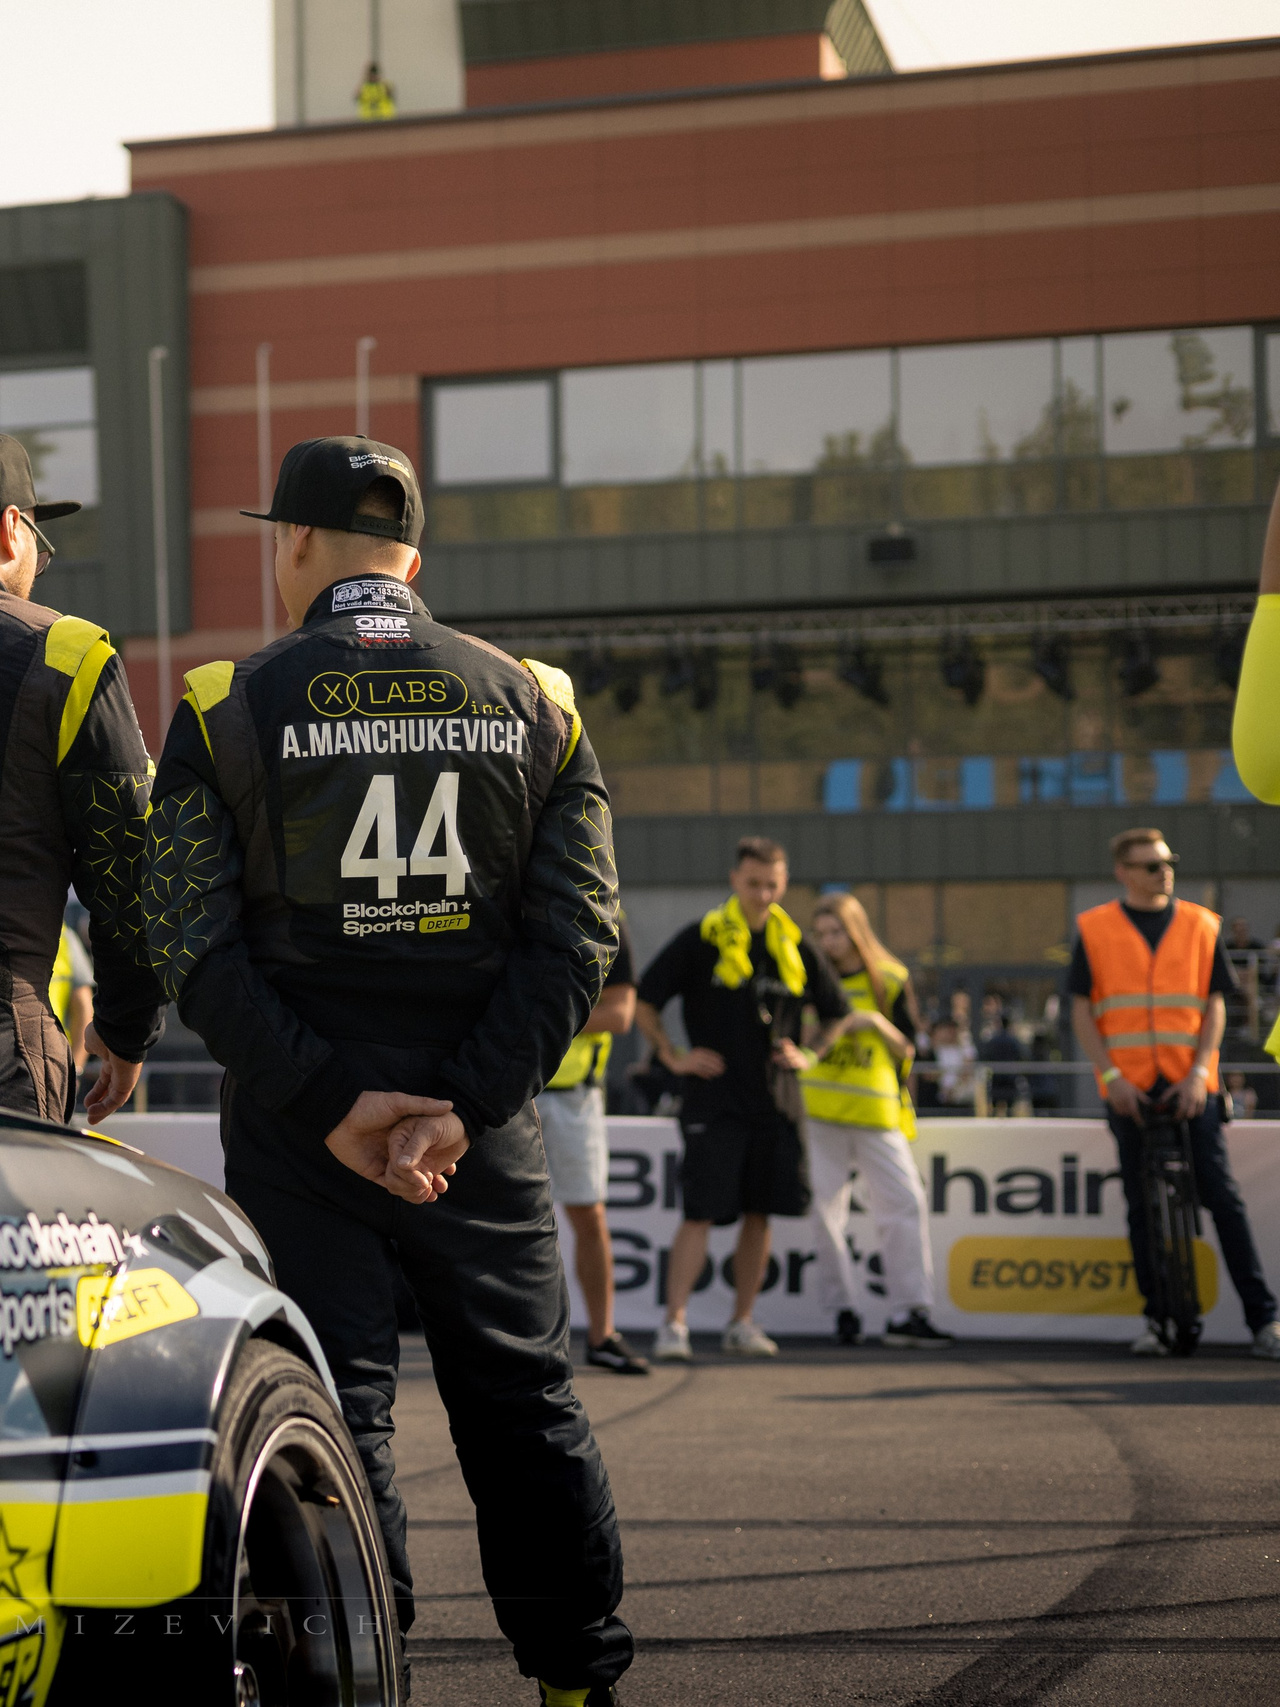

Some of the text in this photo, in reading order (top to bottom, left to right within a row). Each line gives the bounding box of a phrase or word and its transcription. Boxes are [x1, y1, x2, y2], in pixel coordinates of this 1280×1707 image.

[350, 459, 388, 469] Sports
[355, 617, 408, 629] OMP
[322, 680, 515, 716] X LABS inc.
[282, 718, 524, 760] A.MANCHUKEVICH
[340, 771, 472, 899] 44
[343, 900, 458, 918] Blockchain
[342, 917, 463, 938] Sports DRIFT
